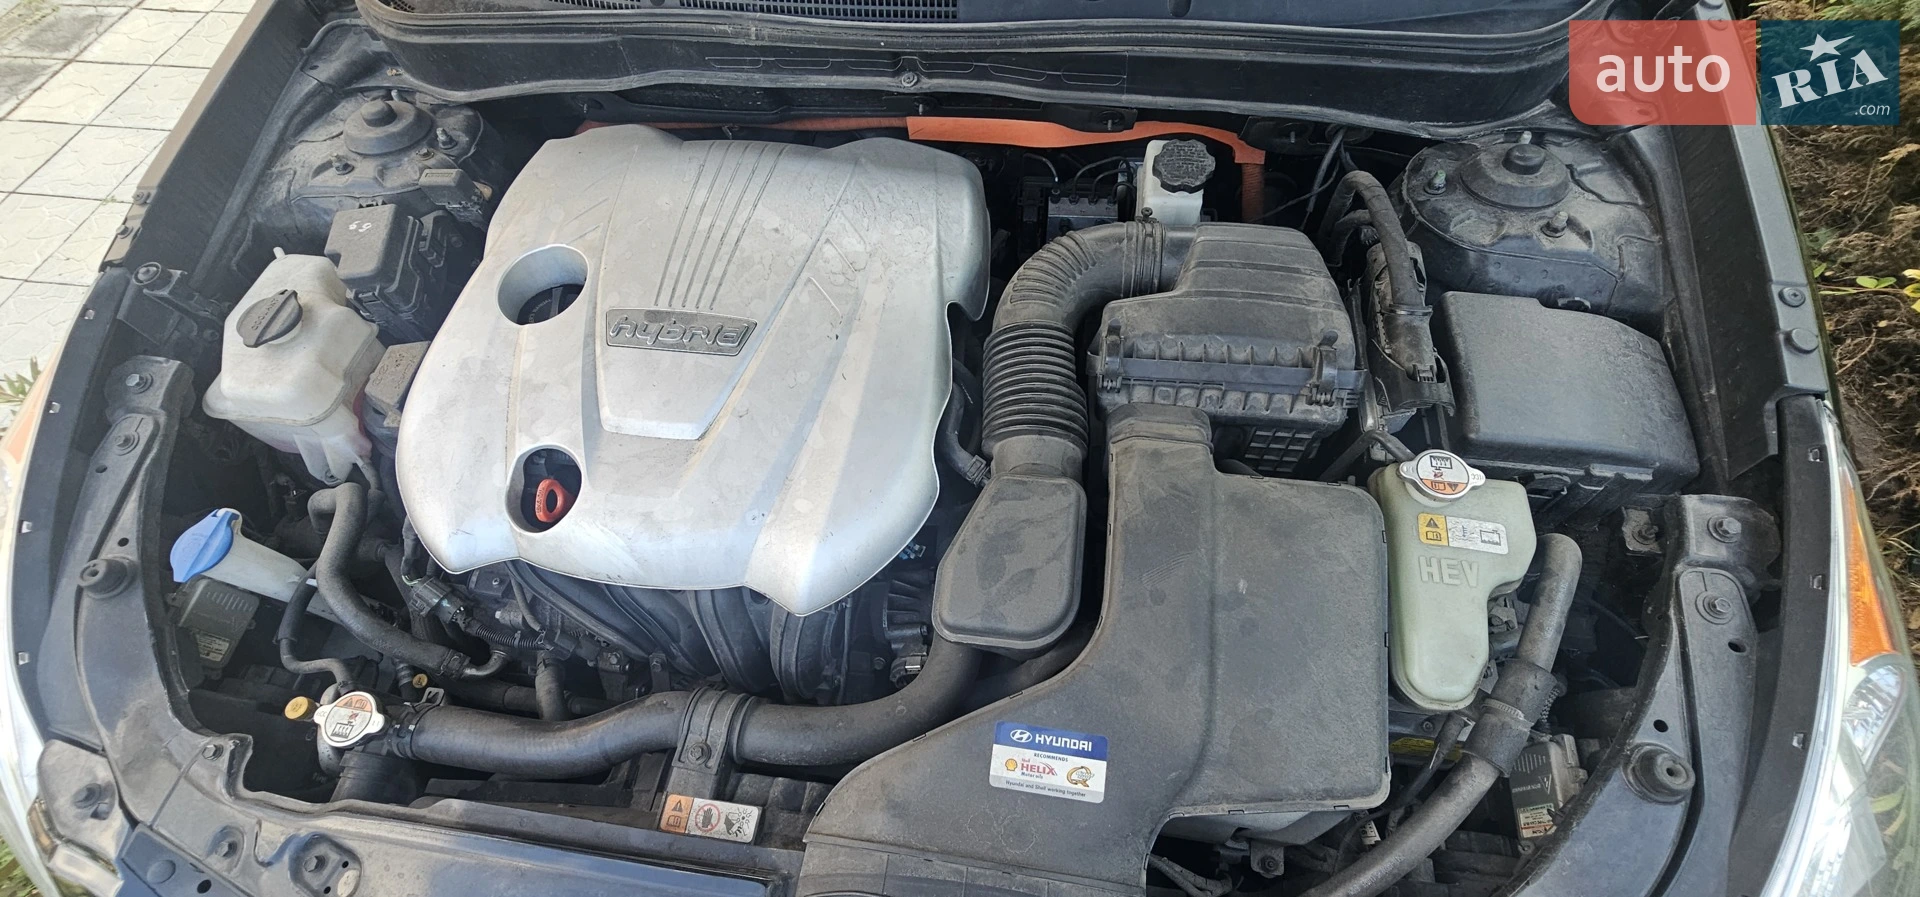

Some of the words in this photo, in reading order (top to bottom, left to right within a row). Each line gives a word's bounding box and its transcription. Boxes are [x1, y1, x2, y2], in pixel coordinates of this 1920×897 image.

[609, 314, 749, 347] hybrid
[1418, 555, 1480, 588] HEV
[1035, 734, 1092, 752] HYUNDAI
[1033, 752, 1069, 762] RECOMMENDS
[1020, 763, 1056, 776] HELIX
[1005, 780, 1025, 788] Hyundai
[1035, 784, 1047, 792] Shell
[1047, 786, 1066, 795] working
[1066, 788, 1086, 797] together
